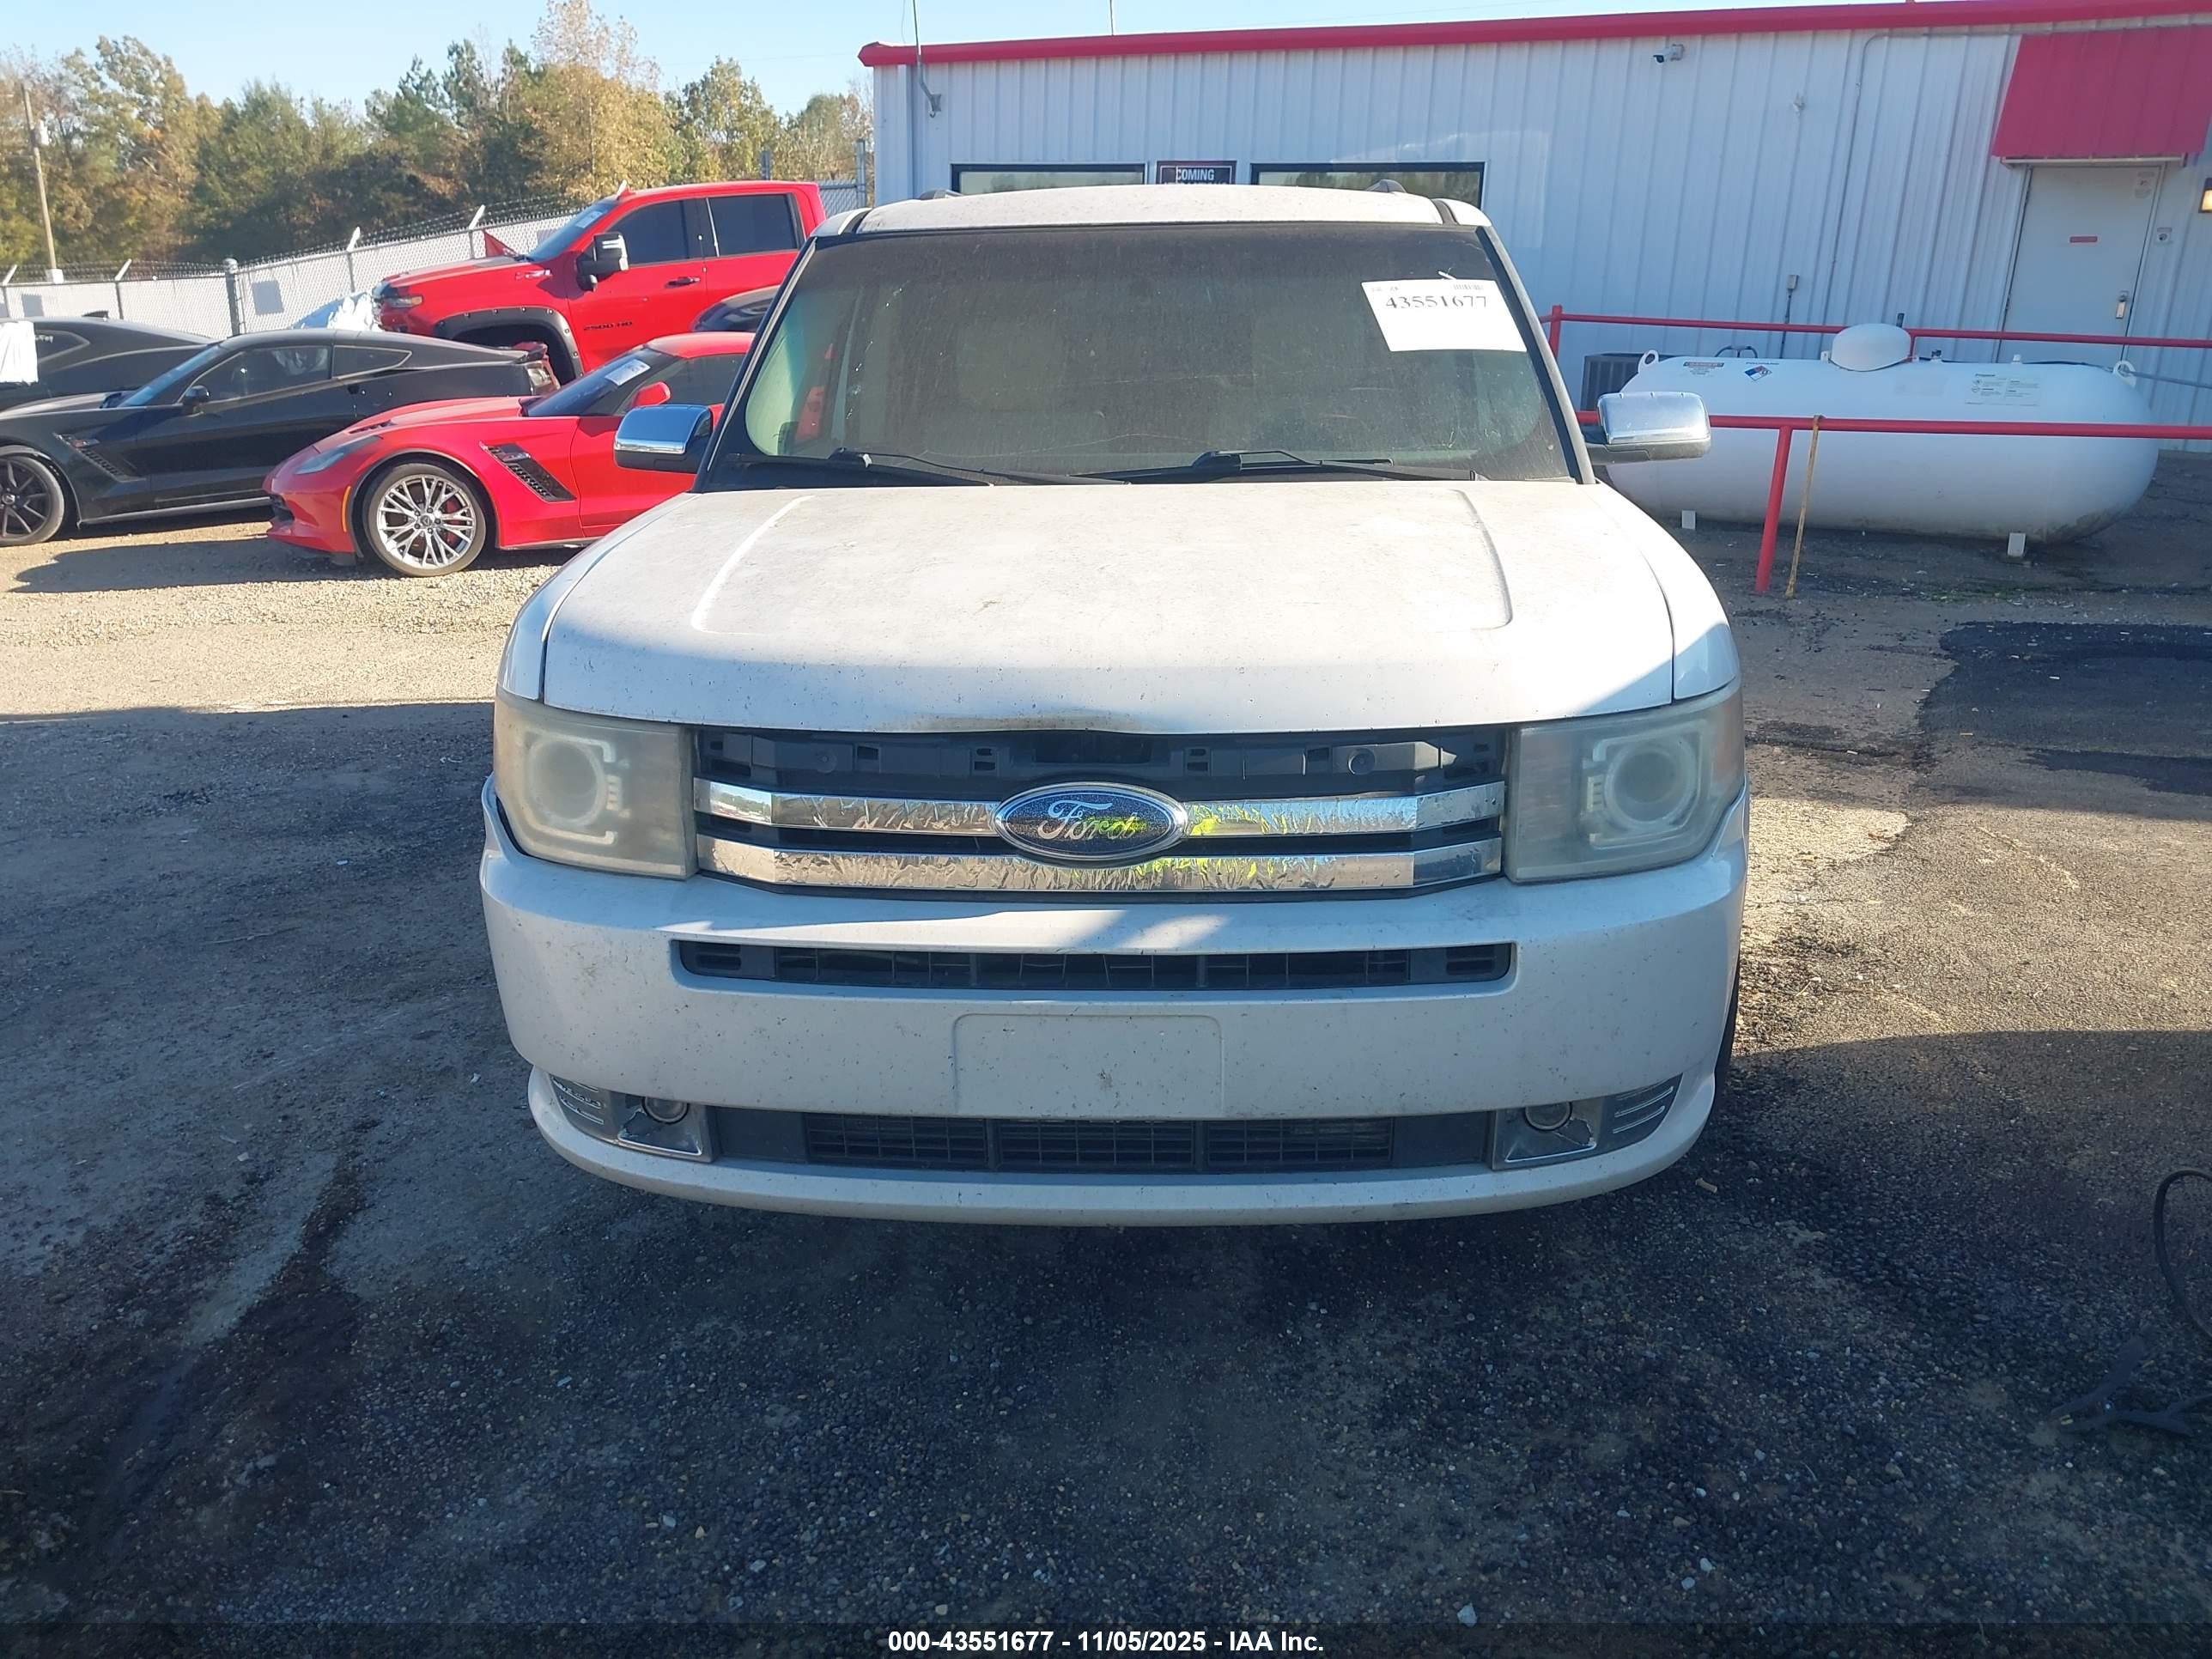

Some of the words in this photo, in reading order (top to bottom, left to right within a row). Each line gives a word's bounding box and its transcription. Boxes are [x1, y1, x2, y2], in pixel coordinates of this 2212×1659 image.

[1176, 168, 1215, 181] COMING
[1385, 295, 1487, 309] 43551677
[1037, 799, 1139, 841] Ford
